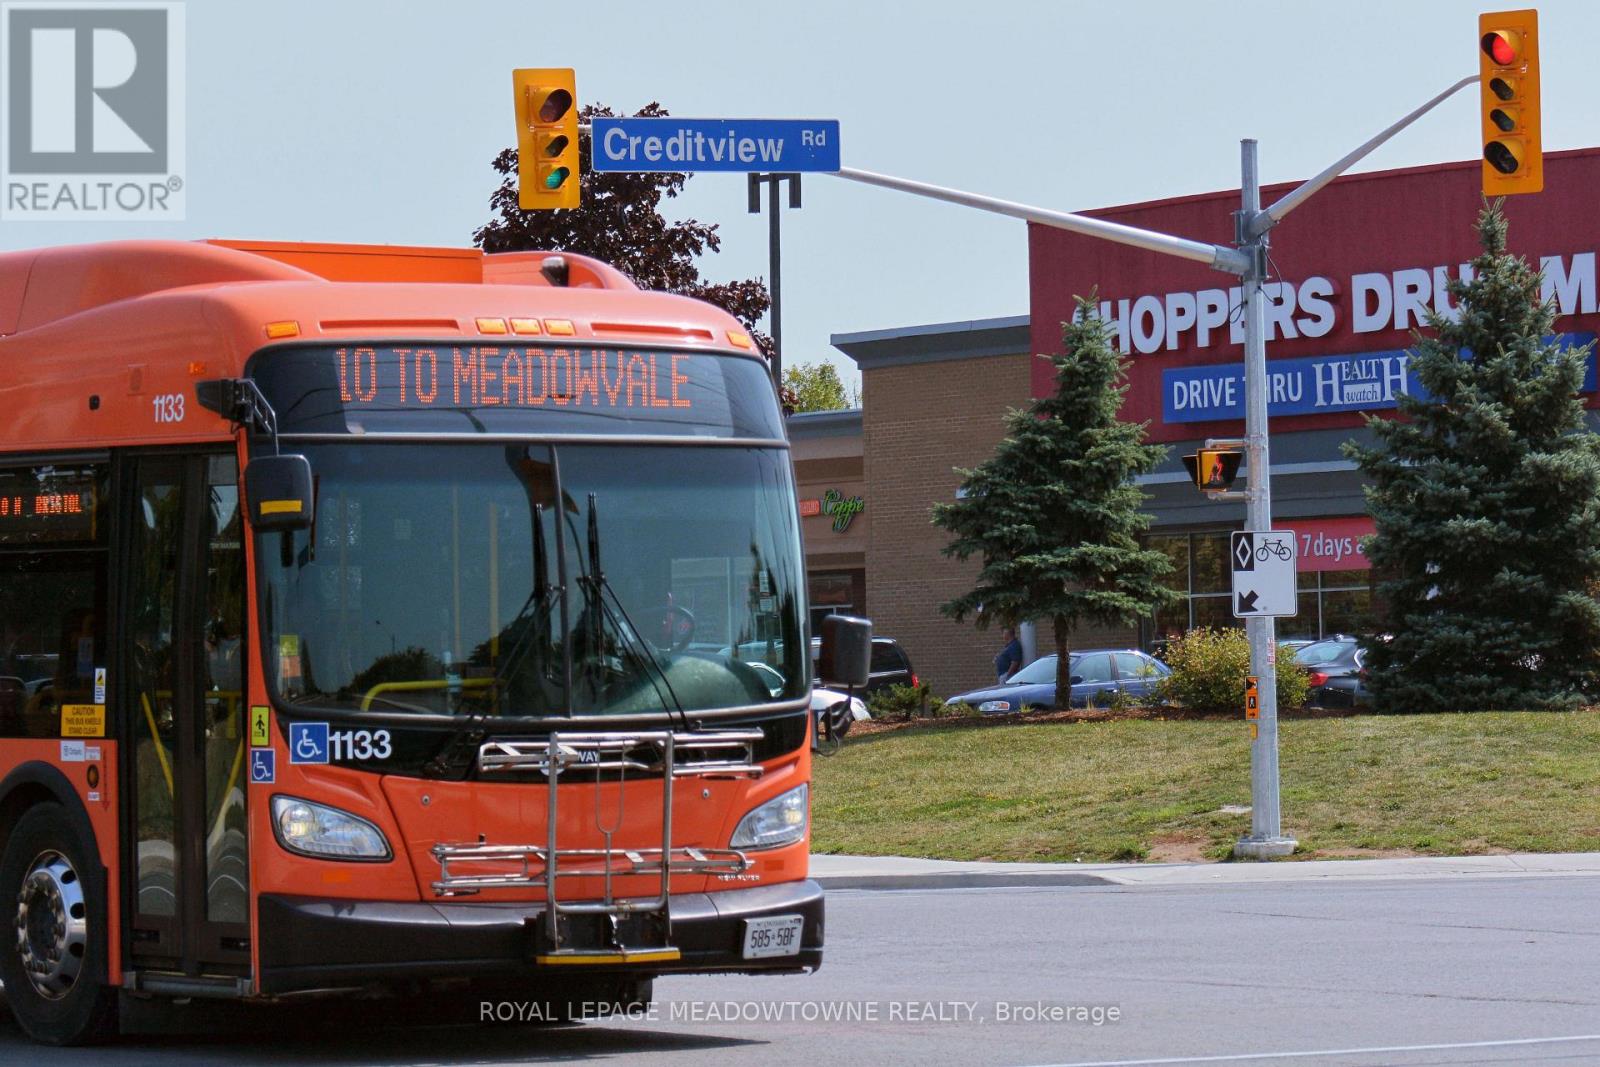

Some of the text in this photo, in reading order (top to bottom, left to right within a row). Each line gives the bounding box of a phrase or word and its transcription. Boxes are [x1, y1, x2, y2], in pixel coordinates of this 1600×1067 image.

[604, 128, 826, 162] Creditview Rd
[1072, 252, 1600, 355] HOPPERS DRU M
[336, 348, 691, 408] 10 TO MEADOWVALE
[1174, 377, 1236, 410] DRIVE
[1312, 356, 1408, 407] HEALTH
[1346, 385, 1379, 401] watch
[153, 394, 185, 422] 1133
[1302, 534, 1312, 557] 7
[1314, 532, 1352, 562] days
[329, 730, 392, 760] 1133
